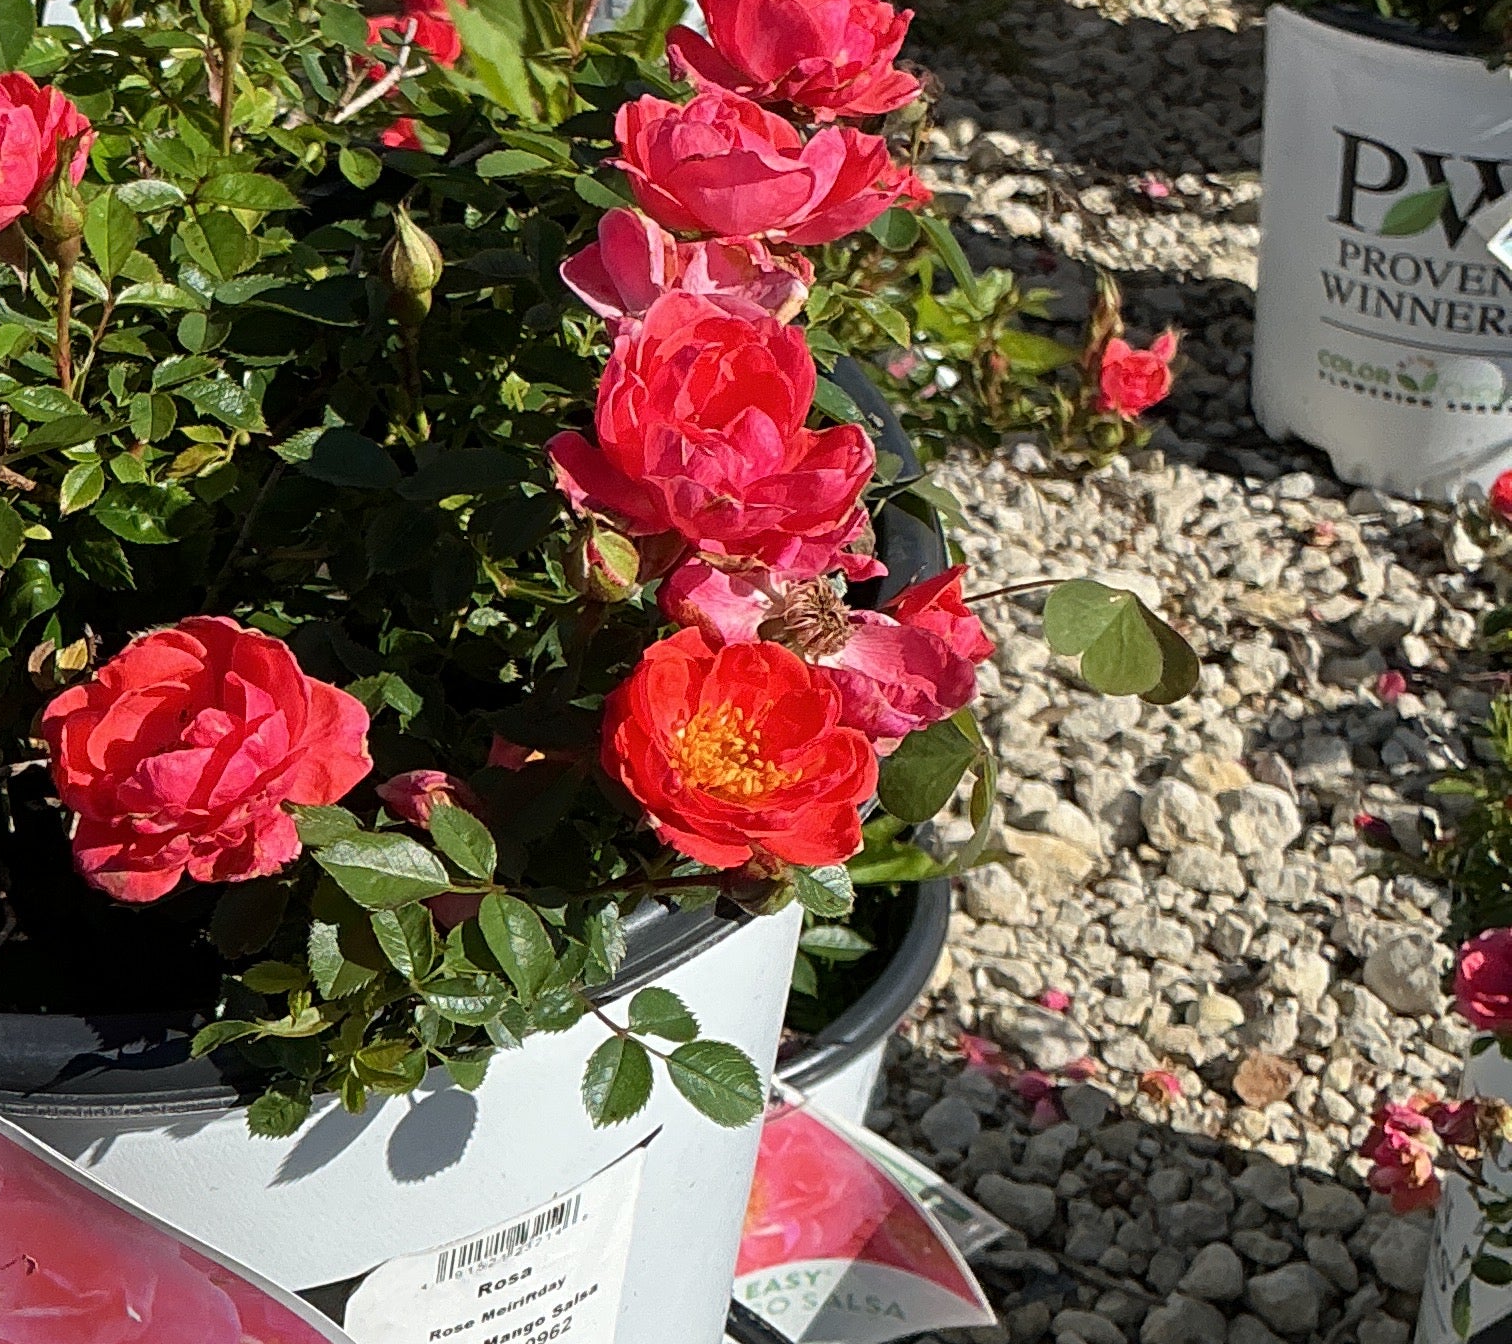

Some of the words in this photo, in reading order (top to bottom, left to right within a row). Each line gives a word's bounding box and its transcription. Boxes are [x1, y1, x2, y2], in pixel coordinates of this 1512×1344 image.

[1340, 239, 1512, 297] PROVEN
[1321, 269, 1512, 336] WINNER
[477, 1266, 533, 1298] Rosa
[551, 1284, 598, 1319] Salsa
[429, 1319, 475, 1342] Rose
